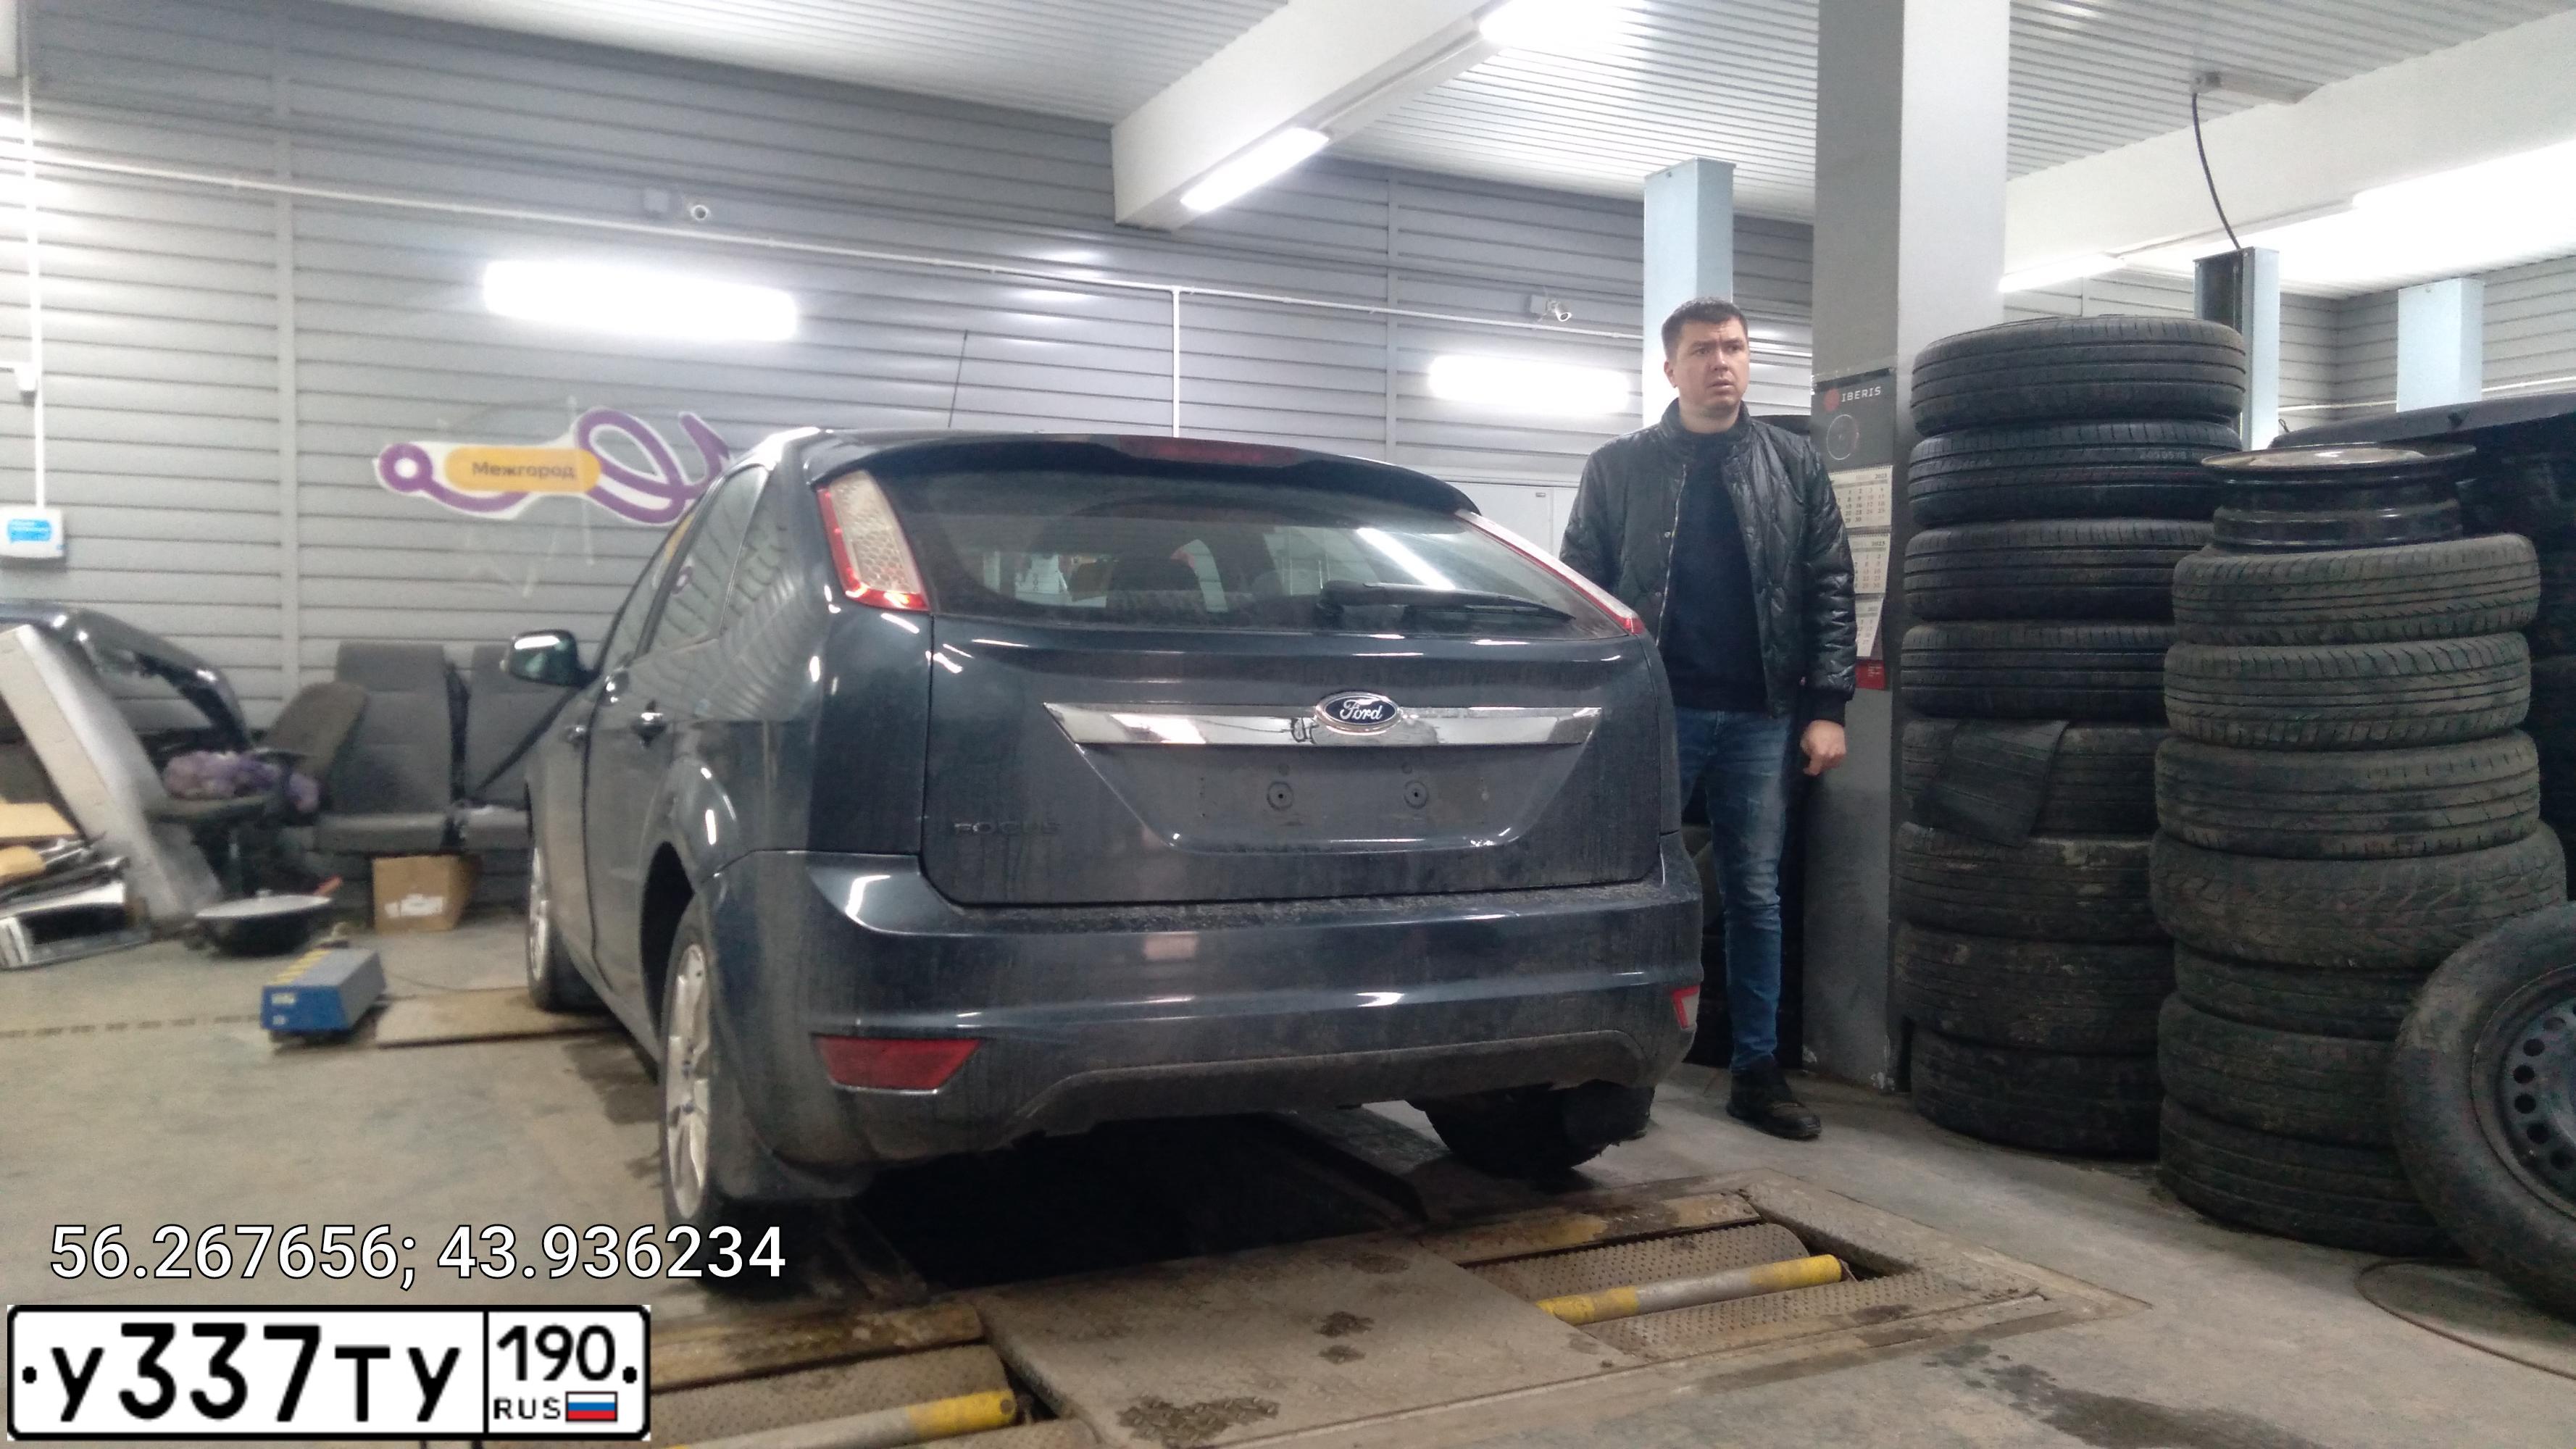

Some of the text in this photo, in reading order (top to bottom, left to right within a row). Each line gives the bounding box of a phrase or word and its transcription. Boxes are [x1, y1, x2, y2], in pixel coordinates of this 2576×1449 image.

[1841, 386, 1881, 402] IBERIS
[472, 462, 575, 480] Межгород
[1339, 699, 1383, 720] Ford
